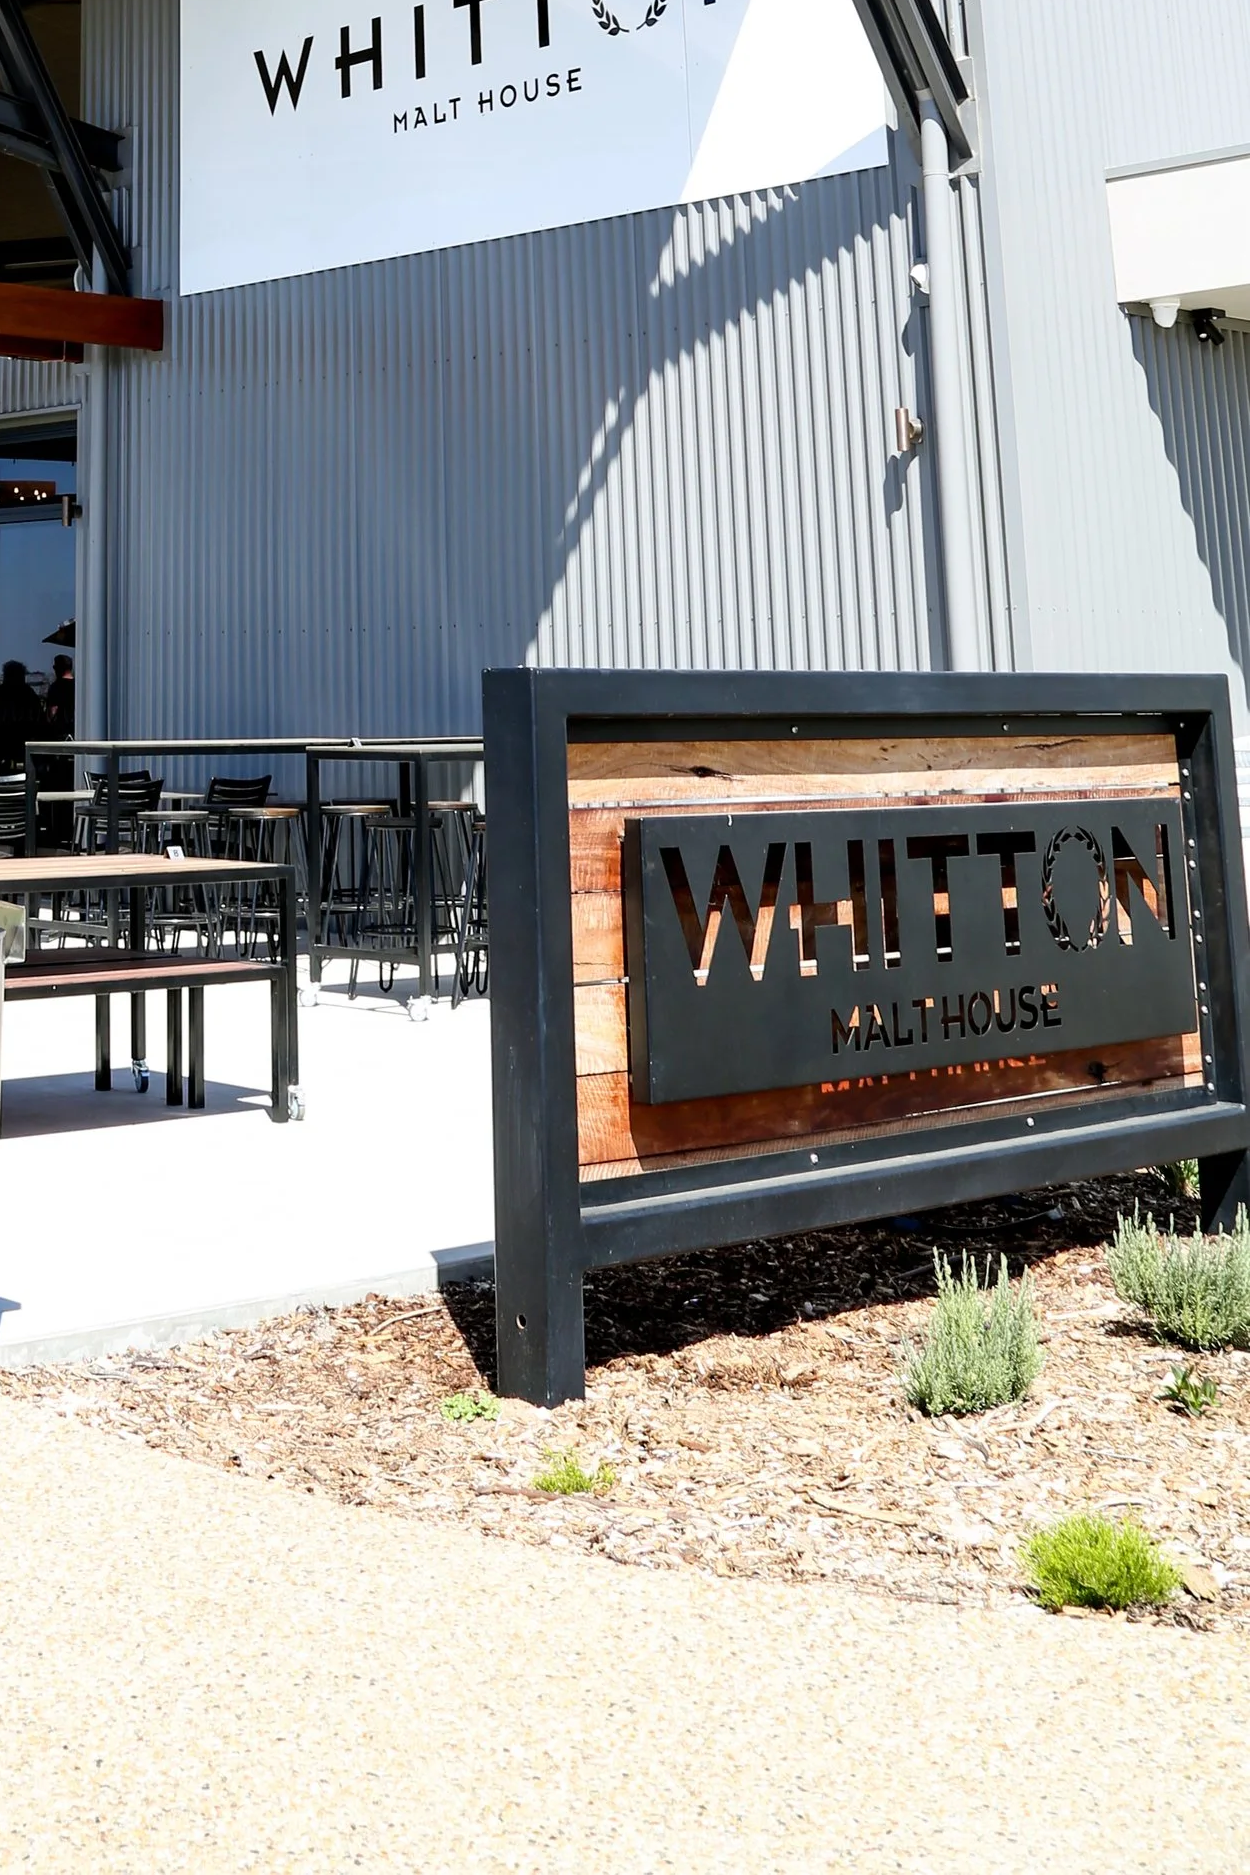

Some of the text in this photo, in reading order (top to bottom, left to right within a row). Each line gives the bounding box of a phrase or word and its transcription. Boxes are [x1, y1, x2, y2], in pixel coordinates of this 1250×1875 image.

[393, 67, 582, 133] MALT HOUSE
[659, 823, 1177, 987] WHITTON
[830, 983, 1063, 1055] MALT HOUSE
